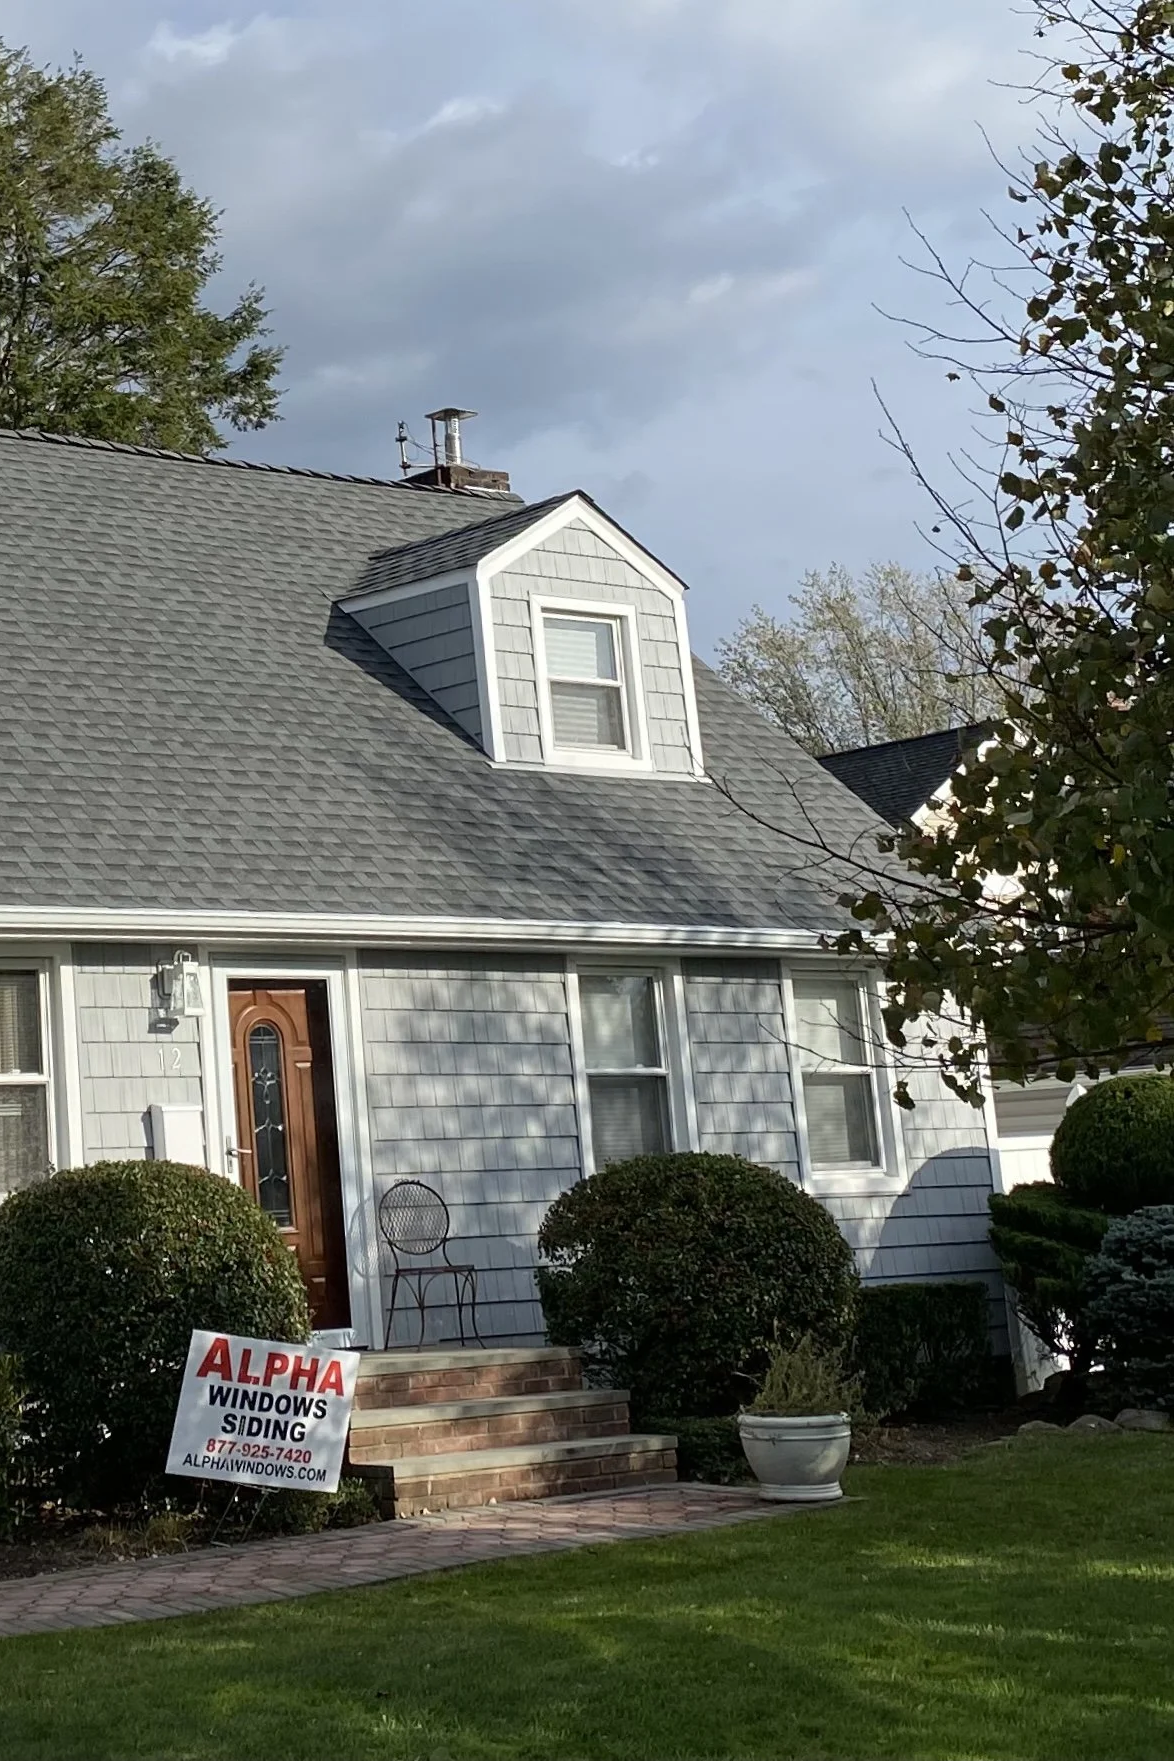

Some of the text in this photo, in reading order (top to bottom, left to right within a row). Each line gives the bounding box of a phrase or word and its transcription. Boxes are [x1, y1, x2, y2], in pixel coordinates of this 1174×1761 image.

[157, 1047, 182, 1071] 12
[196, 1336, 344, 1397] ALPHA
[208, 1384, 328, 1419] WINDOWS
[221, 1413, 306, 1442] SIDING
[206, 1438, 312, 1464] 877-925-7420
[182, 1453, 327, 1482] ALPHAWINDOWS.COM
